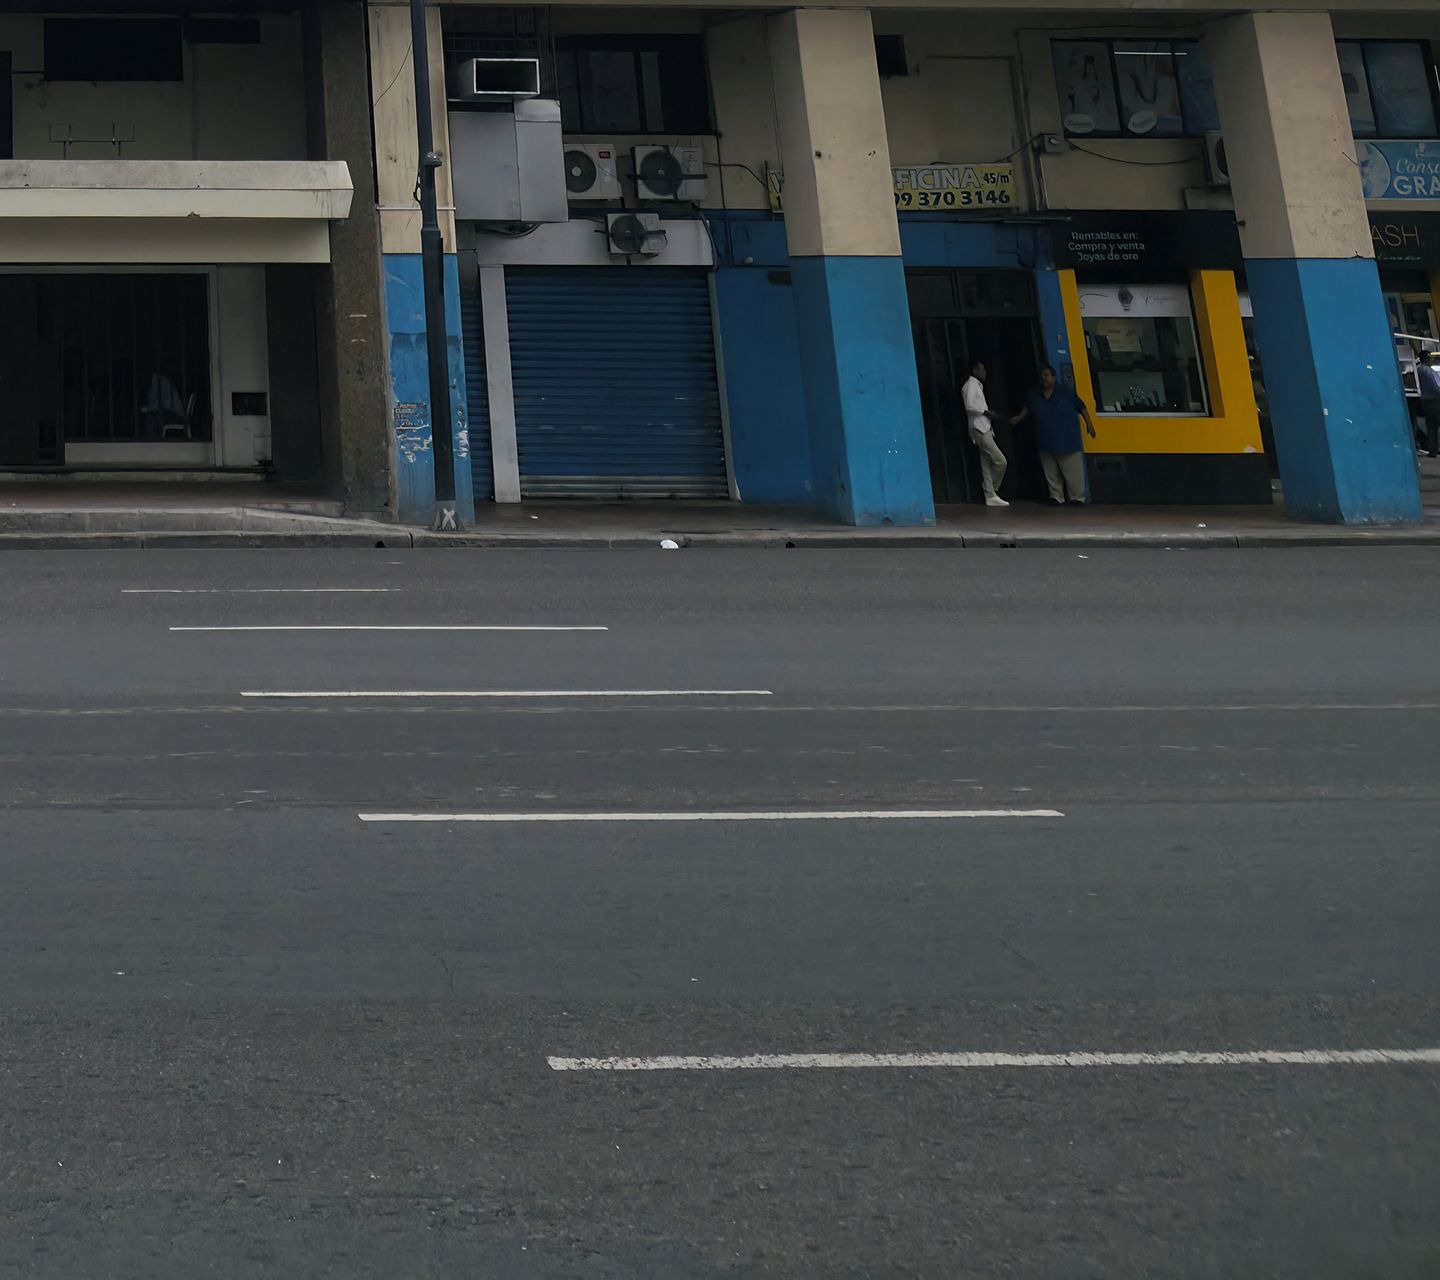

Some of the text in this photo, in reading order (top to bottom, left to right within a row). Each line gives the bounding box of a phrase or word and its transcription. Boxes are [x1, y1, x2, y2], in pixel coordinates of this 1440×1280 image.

[892, 167, 981, 191] FICINA
[918, 191, 956, 208] 370
[960, 190, 1011, 206] 3146
[1071, 231, 1138, 241] Rentables en:
[1068, 241, 1107, 252] Compra
[1117, 242, 1145, 251] venta
[1078, 251, 1139, 263] Joyas de oro
